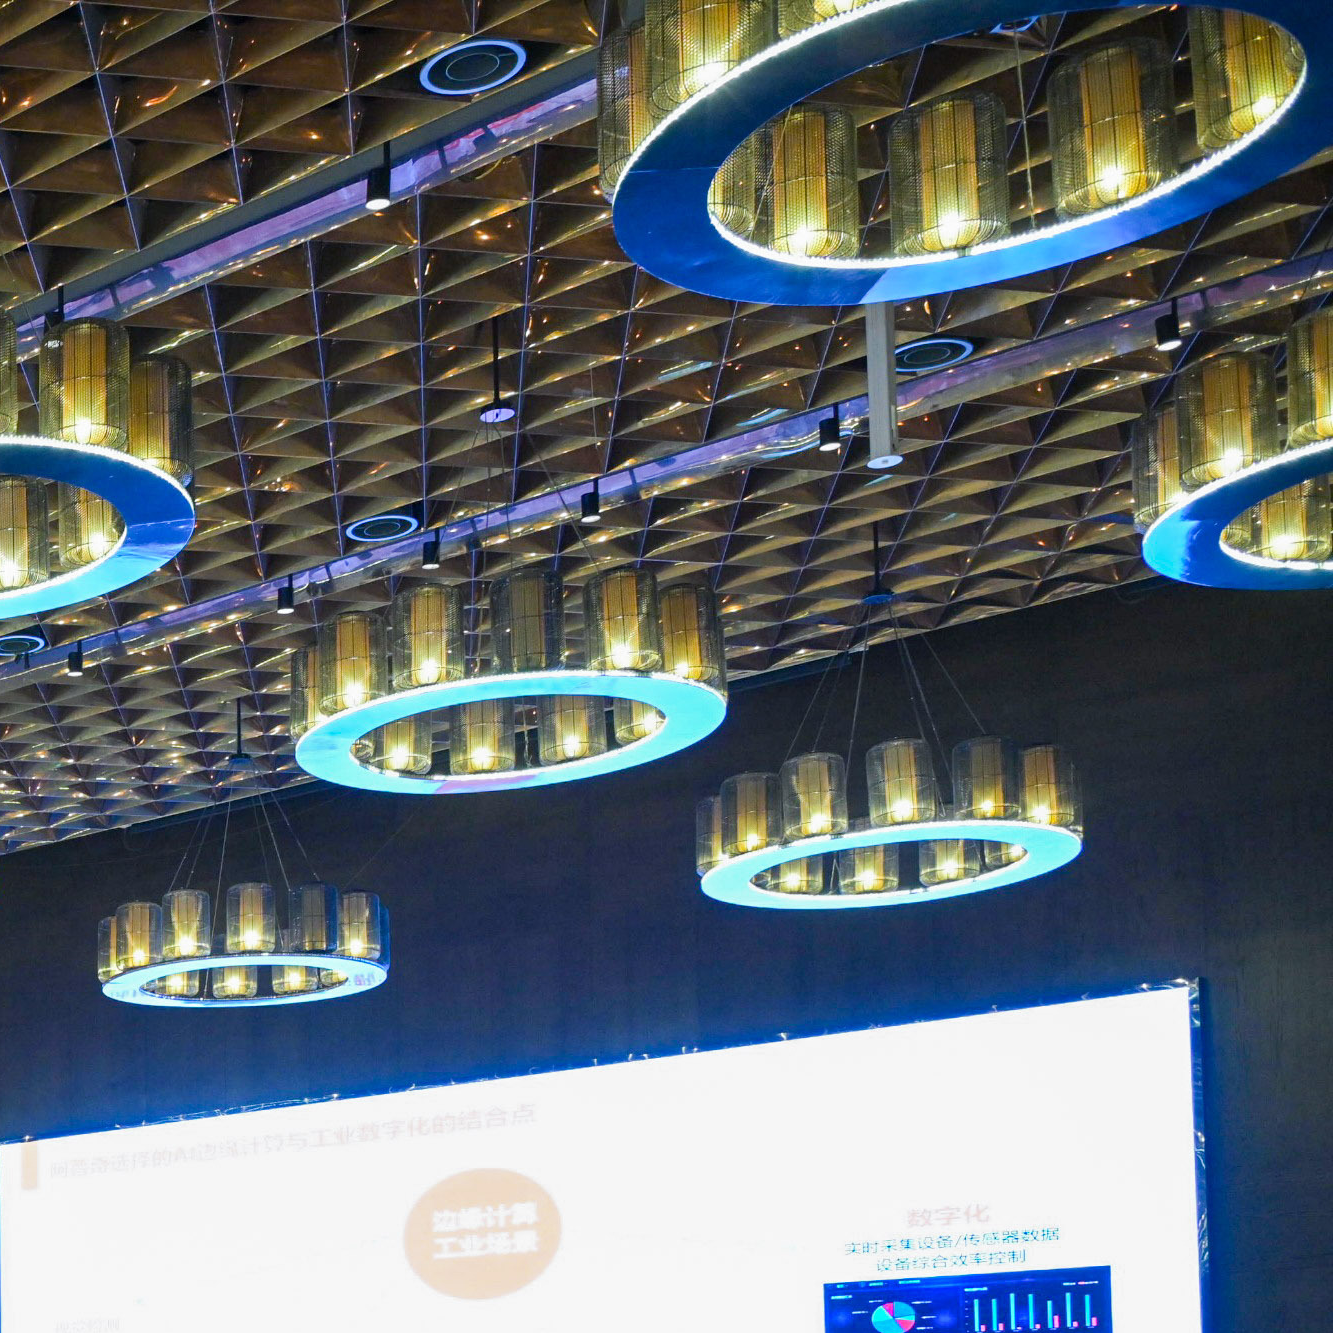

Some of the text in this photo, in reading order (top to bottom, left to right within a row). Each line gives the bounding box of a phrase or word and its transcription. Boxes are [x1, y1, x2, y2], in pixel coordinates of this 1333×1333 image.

[906, 1203, 990, 1228] 数字化
[844, 1226, 1061, 1256] 实时采集设备/传感器数据
[876, 1249, 1027, 1272] 设备综合效率控制
